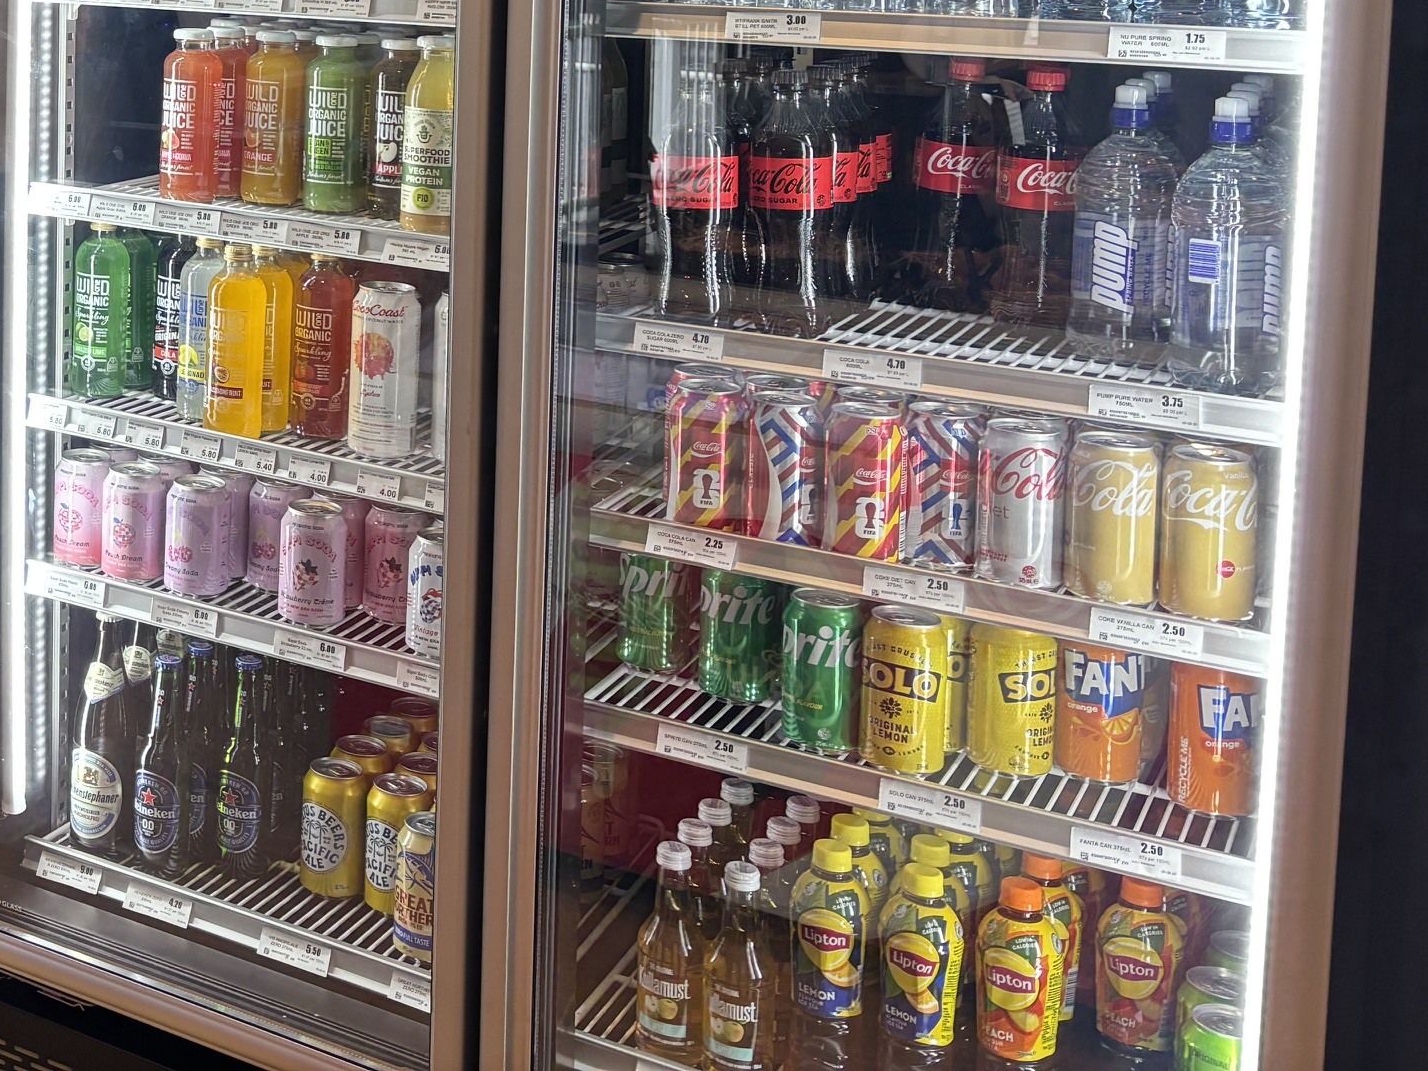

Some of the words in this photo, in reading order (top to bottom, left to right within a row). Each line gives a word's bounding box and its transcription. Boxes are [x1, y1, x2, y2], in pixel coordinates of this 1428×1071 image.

[786, 14, 807, 25] 3.00
[1185, 32, 1206, 44] 1.75
[246, 83, 279, 102] WILD
[308, 90, 347, 109] WILD
[162, 111, 195, 129] JUICE
[308, 108, 347, 120] ORGANIC
[244, 112, 278, 129] JUICE
[307, 119, 346, 137] JUICE
[408, 166, 440, 177] VEGAN
[405, 175, 443, 186] PROTEIN
[132, 202, 147, 212] 6.00
[196, 211, 212, 221] 5.80
[262, 220, 278, 230] 5.80
[334, 230, 351, 240] 5.80
[1090, 220, 1140, 314] pump
[75, 294, 109, 307] ORGANIC
[353, 299, 406, 318] CocoCoast
[296, 308, 333, 330] WILD
[295, 326, 332, 342] ORGANIC
[692, 332, 710, 344] 4.70
[294, 342, 332, 362] Sparkling
[886, 358, 906, 370] 4.70
[1132, 396, 1154, 404] WATER
[1161, 395, 1183, 408] 3.75
[49, 416, 63, 425] 5.80
[96, 426, 112, 437] 5.80
[144, 437, 160, 447] 5.80
[693, 441, 723, 453] Coca-Cola
[201, 449, 217, 459] 5.80
[256, 461, 272, 472] 5.40
[310, 473, 327, 483] 4.00
[855, 467, 886, 480] Coca-Cola
[942, 468, 970, 480] Coca-Cola
[1224, 471, 1249, 479] Vanilla
[379, 488, 397, 499] 4.00
[704, 537, 723, 549] 2.25
[181, 567, 199, 577] Soda
[83, 580, 97, 591] 6.00
[904, 578, 916, 586] CAN
[927, 578, 949, 591] 2.50
[194, 609, 209, 621] 6.00
[1097, 615, 1116, 624] COKE
[1116, 619, 1141, 628] VANILLA
[1141, 623, 1155, 631] CAN
[1162, 622, 1186, 637] 2.50
[320, 643, 336, 654] 6.00
[1004, 670, 1056, 700] SOL
[1067, 701, 1099, 713] orange
[867, 714, 916, 736] ORIGINAL
[872, 729, 909, 744] LEMON
[1182, 735, 1189, 749] ME
[714, 740, 734, 753] 2.50
[1177, 750, 1188, 802] RECYCLE
[889, 789, 905, 798] SOLO
[905, 793, 917, 801] CAN
[944, 795, 966, 809] 2.50
[317, 809, 345, 851] BEERS
[1079, 838, 1099, 847] FANTA
[1099, 841, 1113, 849] CAN
[1140, 842, 1163, 856] 2.50
[304, 855, 325, 869] ALE
[80, 865, 94, 876] 9.00
[369, 873, 390, 888] ALE
[1, 900, 22, 912] GLASS
[168, 897, 183, 909] 4.20
[414, 937, 430, 947] TASTE
[804, 926, 847, 946] Lipton
[305, 944, 322, 957] 5.50
[892, 950, 933, 975] Lipton
[1110, 958, 1155, 978] Lipton
[987, 968, 1033, 991] Lipton
[798, 982, 836, 1001] LEMON
[885, 1004, 917, 1025] LEMON
[1104, 1010, 1136, 1029] PEACH
